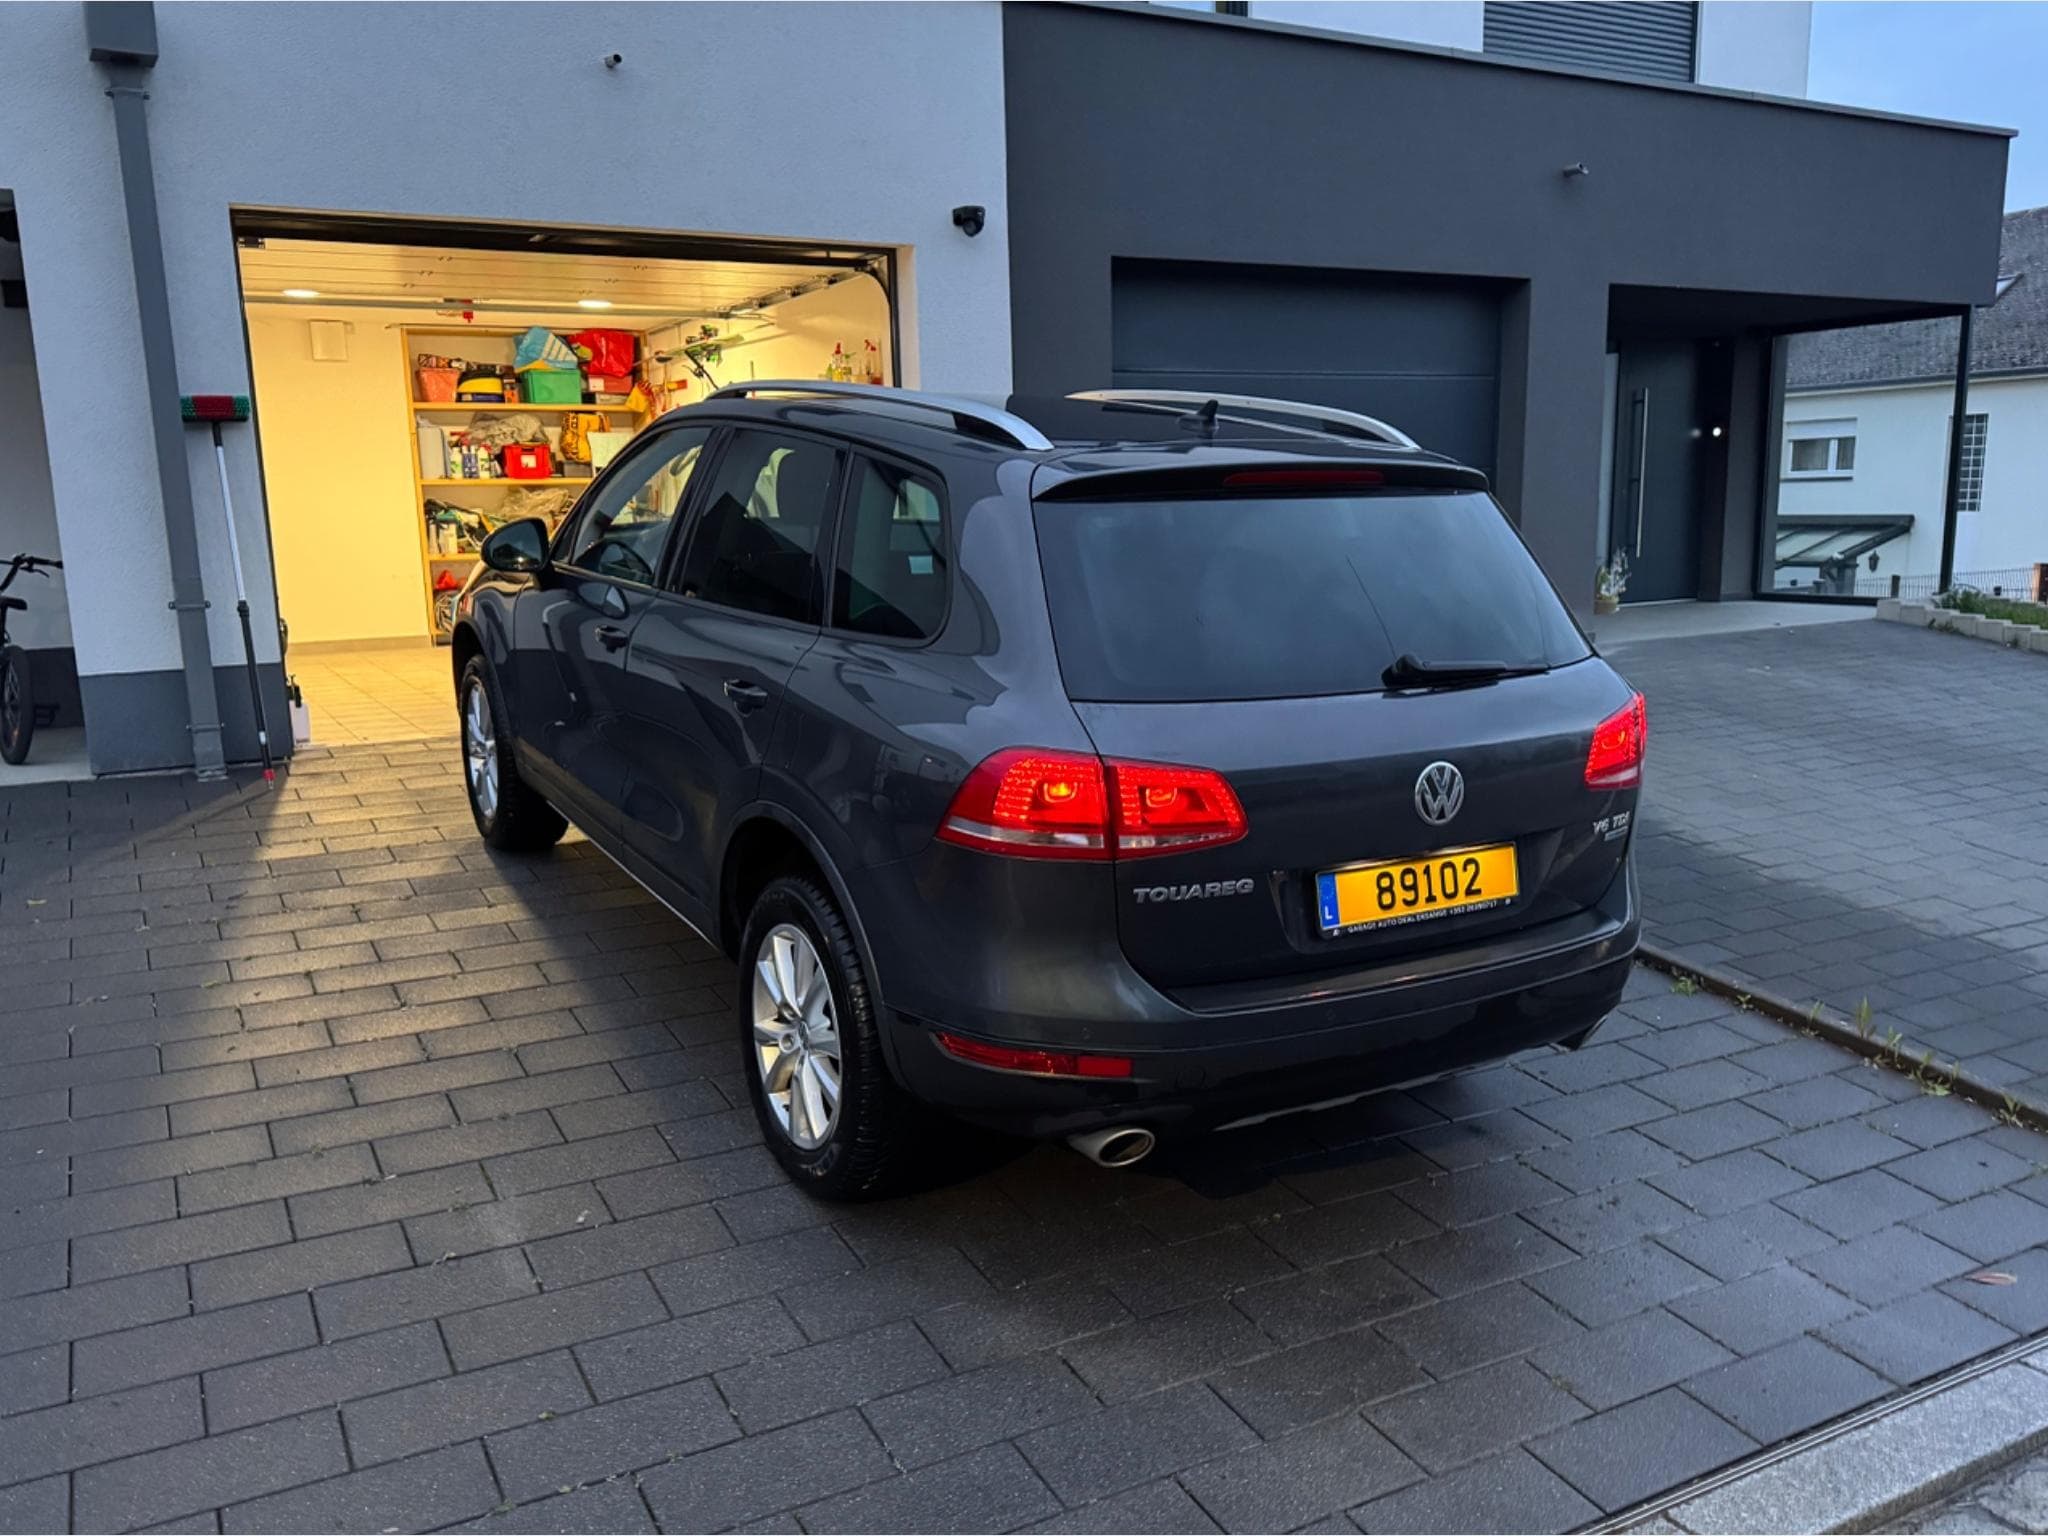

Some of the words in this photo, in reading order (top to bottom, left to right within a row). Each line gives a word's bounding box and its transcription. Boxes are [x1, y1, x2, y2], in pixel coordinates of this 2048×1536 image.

[1613, 811, 1630, 828] TDI
[1133, 878, 1254, 903] TOUAREG
[1376, 857, 1482, 911] 89102
[1325, 905, 1333, 919] L
